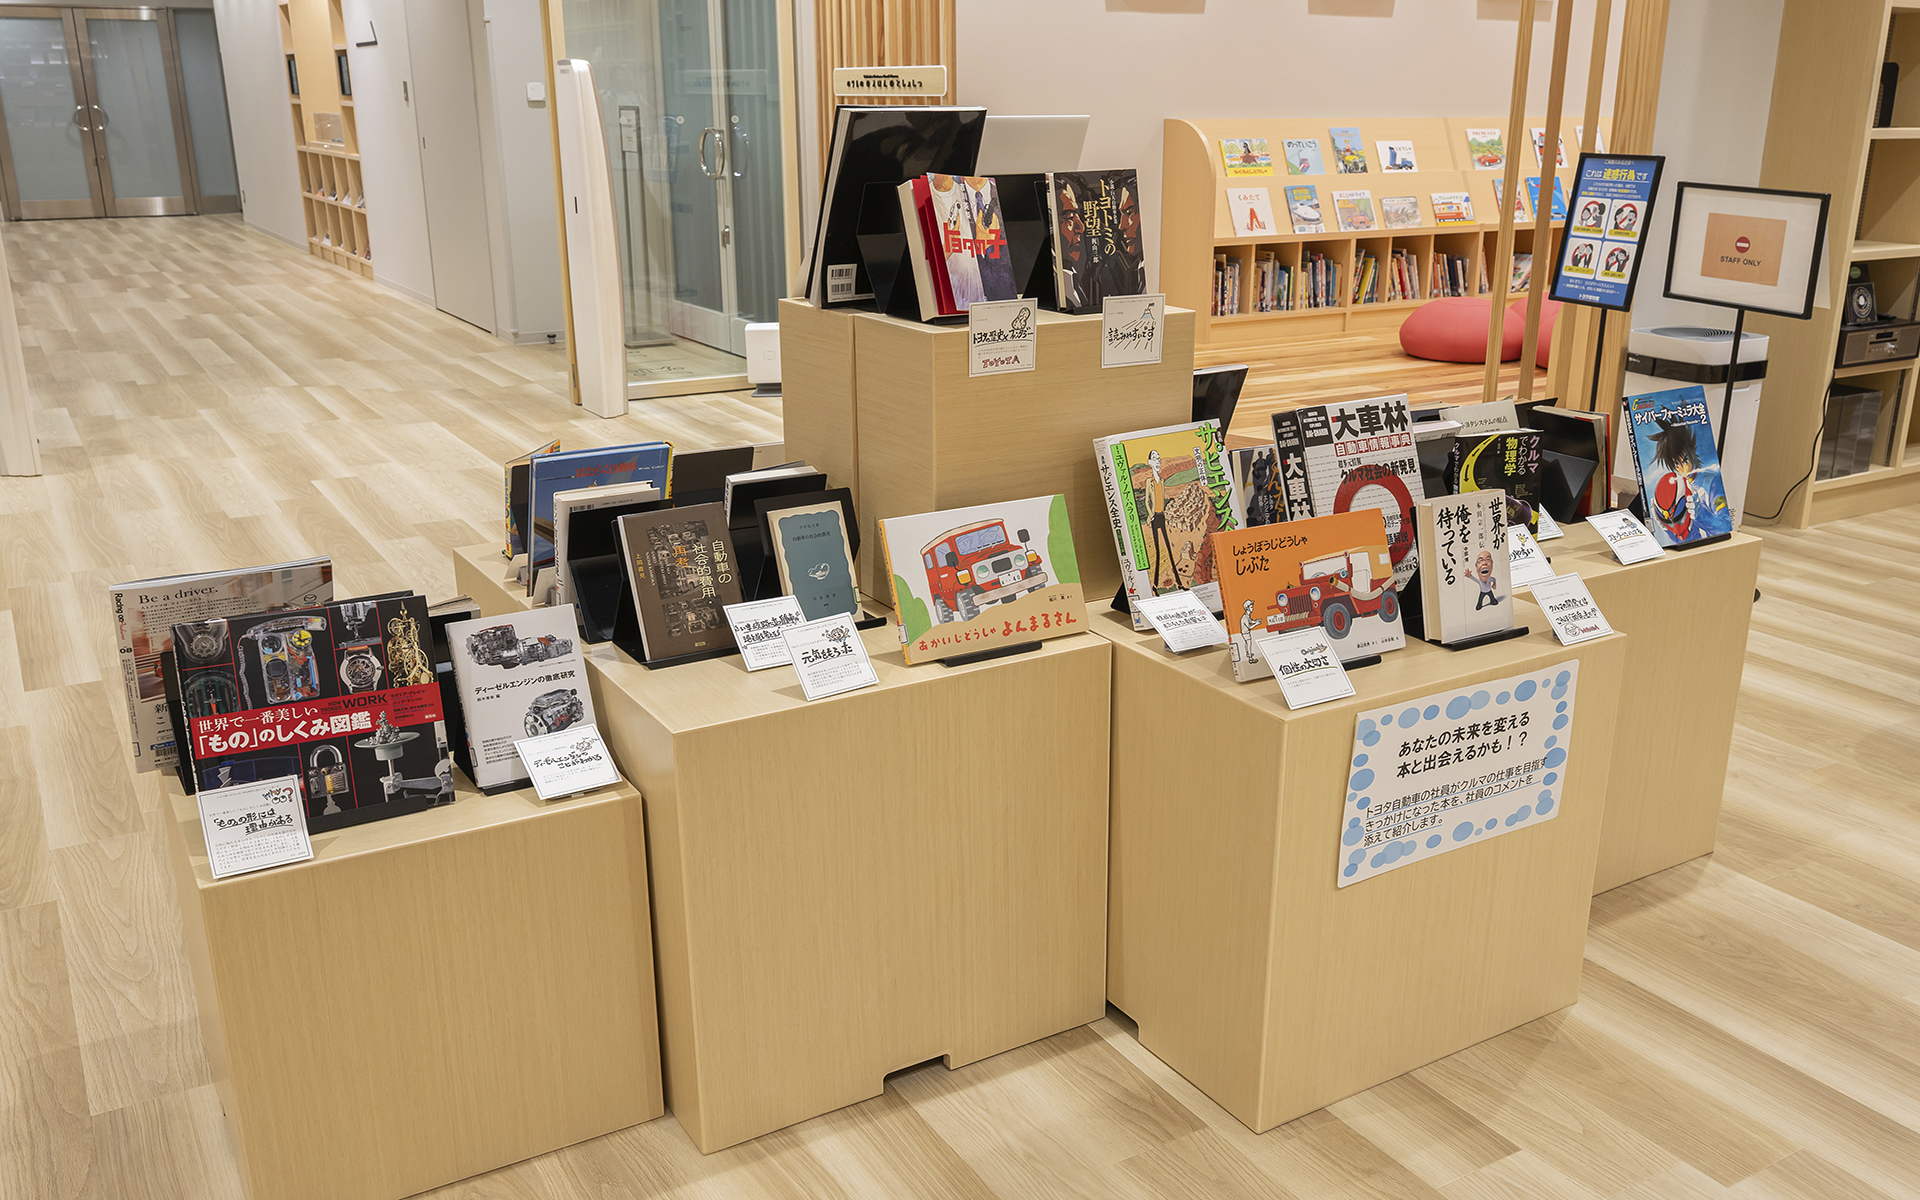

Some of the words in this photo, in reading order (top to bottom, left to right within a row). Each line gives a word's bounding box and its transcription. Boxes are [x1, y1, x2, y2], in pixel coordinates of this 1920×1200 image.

[1586, 170, 1602, 178] これは
[1603, 168, 1635, 181] 迷惑行為
[1636, 172, 1648, 181] です
[1083, 200, 1102, 237] 野望
[1099, 179, 1117, 256] トヨトミの
[1720, 255, 1741, 264] STAFF
[1742, 257, 1761, 267] ONLY
[1331, 400, 1409, 440] 大車林
[1634, 402, 1706, 426] サイバーフォーミュラ大全
[1700, 414, 1708, 425] 2
[1335, 433, 1412, 456] 自動車情報事典
[1504, 436, 1518, 477] 物理学
[1517, 435, 1529, 476] でわかる
[1527, 435, 1540, 473] クルマ
[576, 460, 637, 478] はたらく自動車
[1340, 458, 1417, 485] クルマ社会の新発見
[1100, 464, 1122, 529] サピエンス全史
[1283, 452, 1311, 521] 大車林
[1454, 504, 1472, 544] 俺を
[1488, 496, 1506, 550] 世界が
[673, 545, 689, 568] 再考
[1232, 534, 1309, 557] しょうぼうじどうしゃ
[1436, 506, 1457, 586] 待っている
[1509, 547, 1534, 560] りやすい
[712, 539, 732, 584] 自動車の
[114, 593, 124, 615] Racing
[139, 594, 159, 604] Be
[163, 594, 170, 602] a
[174, 585, 219, 599] driver.
[918, 626, 997, 651] あかいじどうしゃ
[1001, 611, 1077, 637] よんまるさん
[801, 641, 853, 664] 元気をもらった
[1278, 654, 1330, 676] 個性の大切さ
[474, 670, 576, 695] ディーゼルエンジンの徹底研究
[342, 693, 388, 709] WORK
[198, 706, 318, 734] 世界で一番美しい
[199, 710, 372, 755] 「もの」のしくみ図鑑
[1398, 711, 1531, 758] あなたの未来を変える
[1396, 731, 1528, 779] 本と出会えるかも！？
[1365, 774, 1534, 832] きっかけになった本を、社員のコメントを
[1366, 756, 1548, 819] トヨタ自動車の社員がクルマの仕事を目指す
[245, 814, 293, 834] 理由がある
[1363, 816, 1443, 847] 添えて紹介します。
